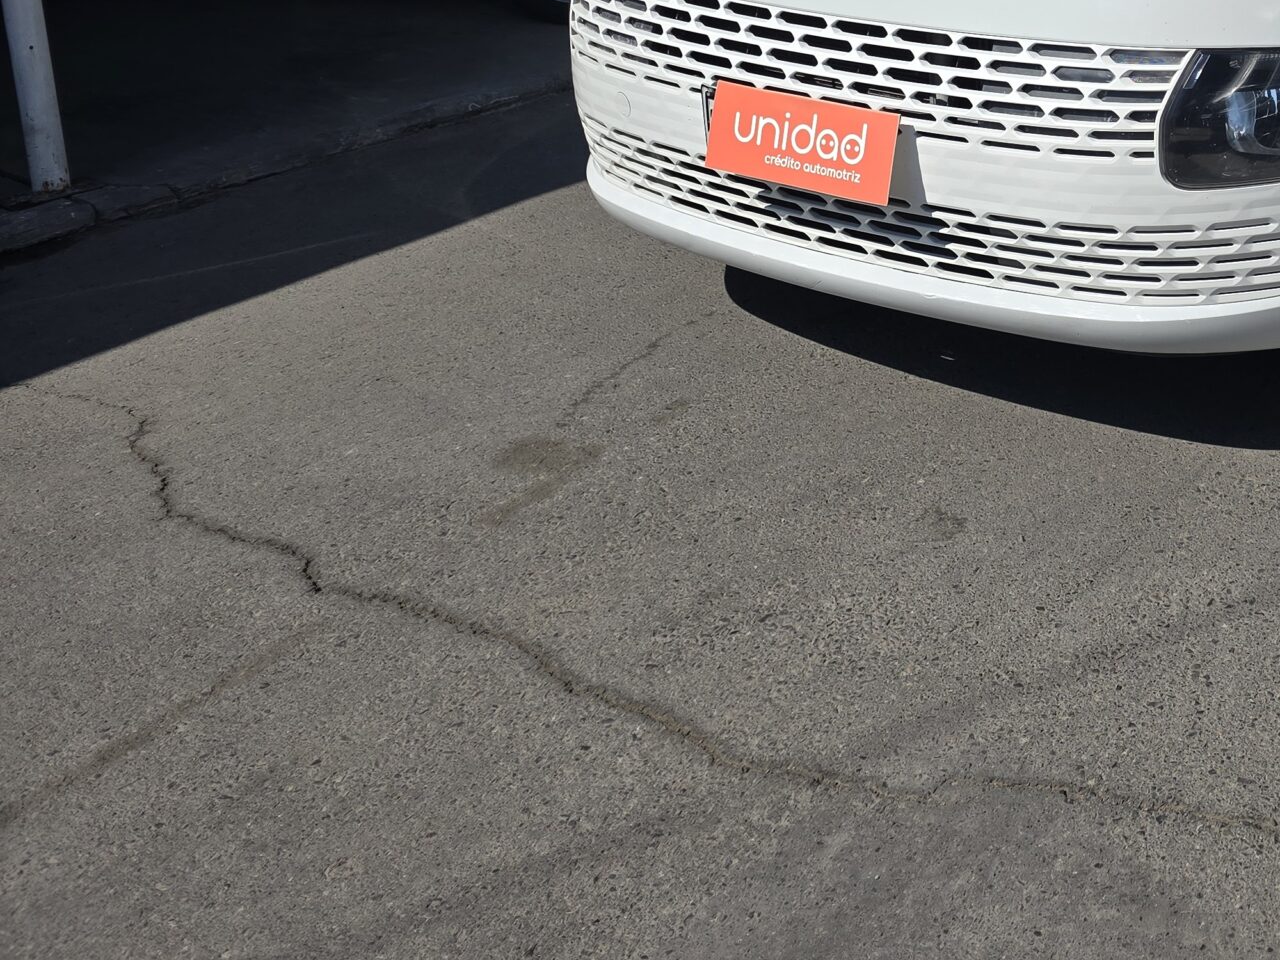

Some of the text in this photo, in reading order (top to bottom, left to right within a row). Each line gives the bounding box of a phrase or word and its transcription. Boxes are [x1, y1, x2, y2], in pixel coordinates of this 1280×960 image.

[733, 111, 868, 165] unidad
[764, 154, 861, 184] crédito automotriz
